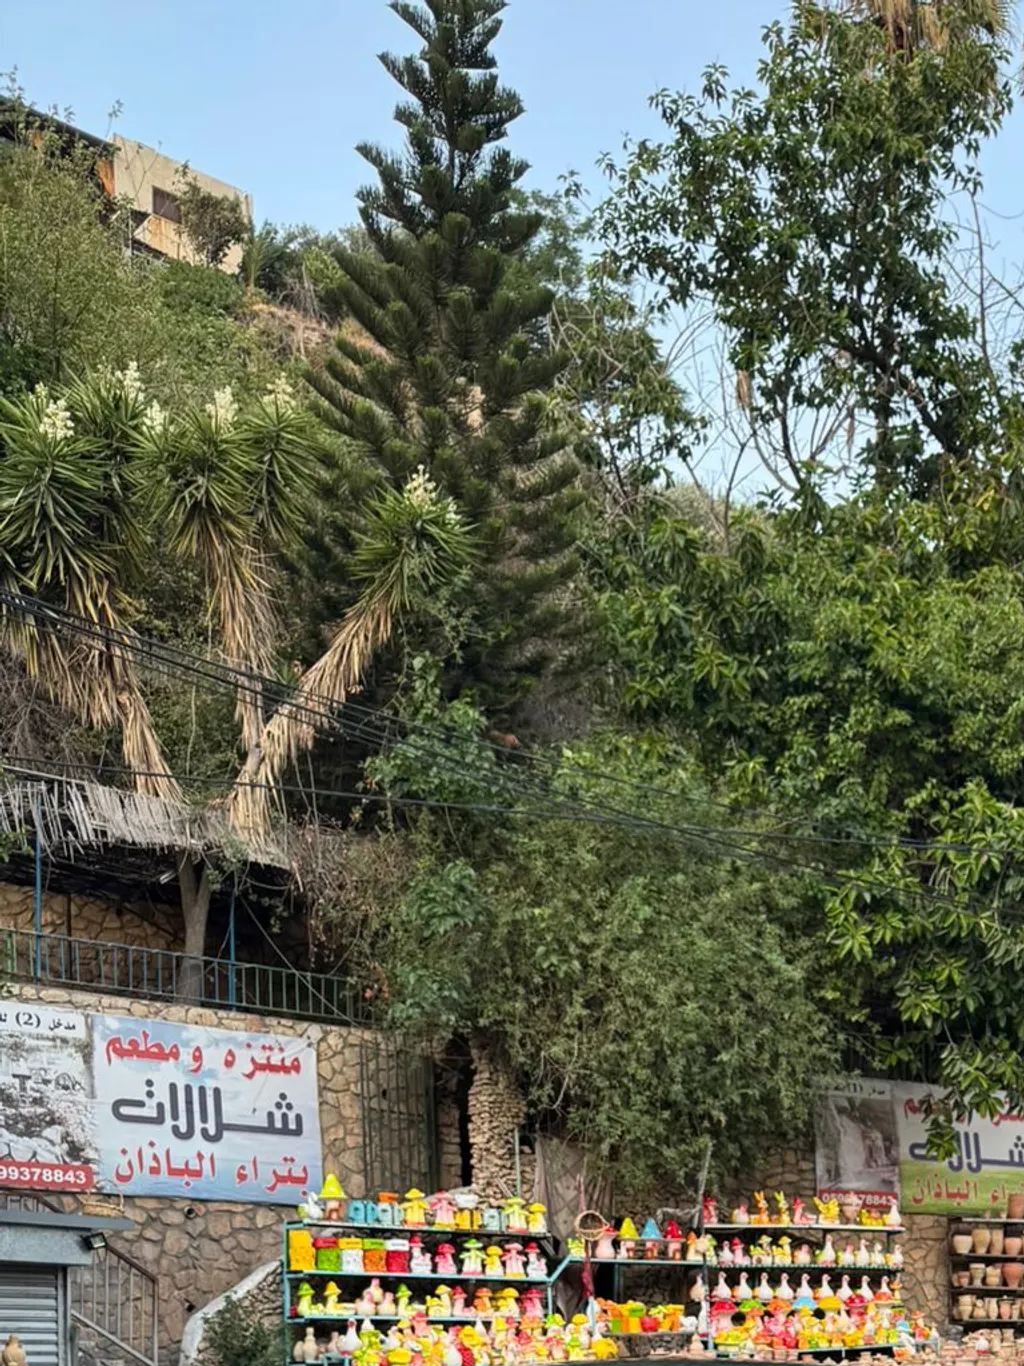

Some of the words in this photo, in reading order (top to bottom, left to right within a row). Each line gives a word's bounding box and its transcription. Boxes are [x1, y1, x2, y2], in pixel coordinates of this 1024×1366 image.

[15, 1011, 41, 1028] (2)
[48, 1017, 76, 1031] مدخل
[105, 1029, 180, 1066] مطعم
[188, 1045, 203, 1073] و
[224, 1042, 301, 1080] منتزه
[111, 1078, 303, 1142] شلالات
[115, 1140, 216, 1187] الباذان
[236, 1155, 310, 1196] بتراء
[911, 1172, 978, 1206] الباذان
